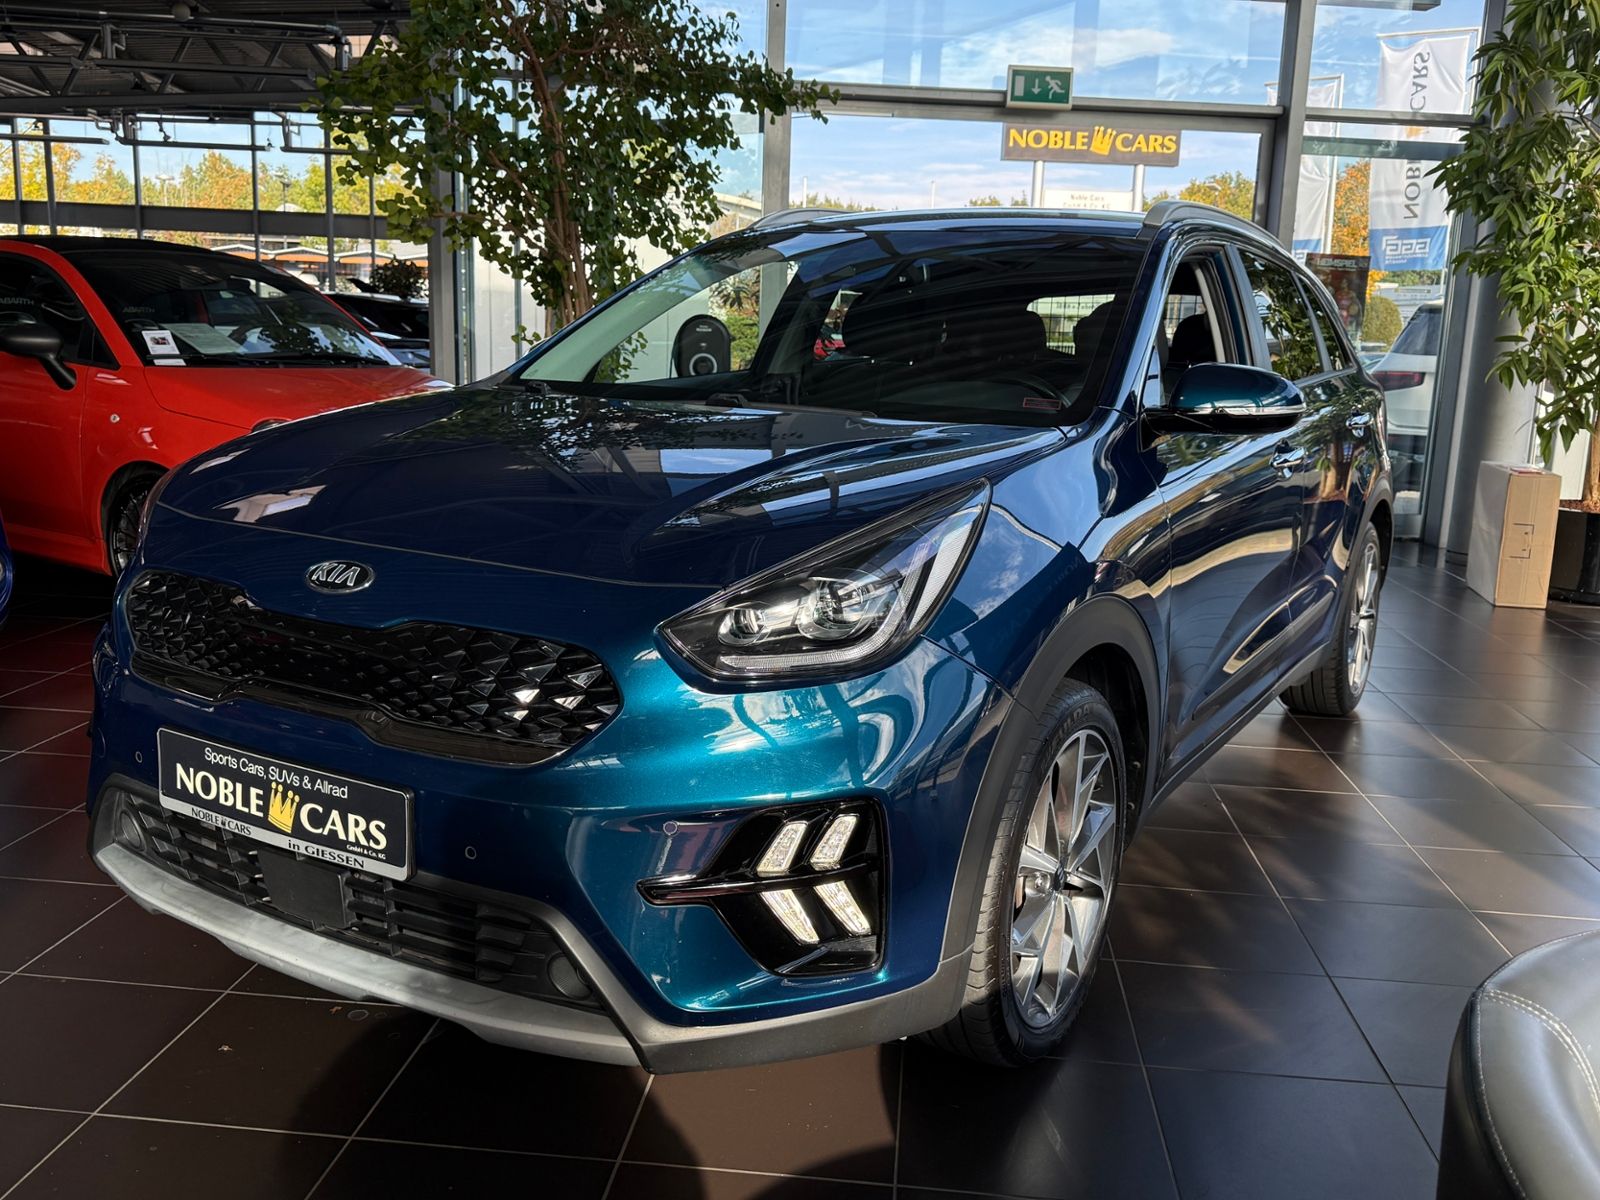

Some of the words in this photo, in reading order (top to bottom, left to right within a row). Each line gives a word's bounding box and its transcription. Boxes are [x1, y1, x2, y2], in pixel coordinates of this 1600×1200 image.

[1008, 128, 1089, 150] NOBLE
[1115, 133, 1177, 154] CARS
[311, 562, 360, 586] KIA
[204, 748, 238, 769] Sports
[239, 758, 266, 780] Cars,
[268, 766, 300, 787] SUVs
[302, 775, 312, 790] &
[314, 778, 348, 799] Allrad
[175, 763, 264, 818] NOBLE
[300, 803, 387, 851] CARS
[191, 807, 220, 826] NOBLE
[227, 818, 252, 836] CARS
[287, 839, 300, 851] in
[304, 841, 365, 869] GIESSEN
